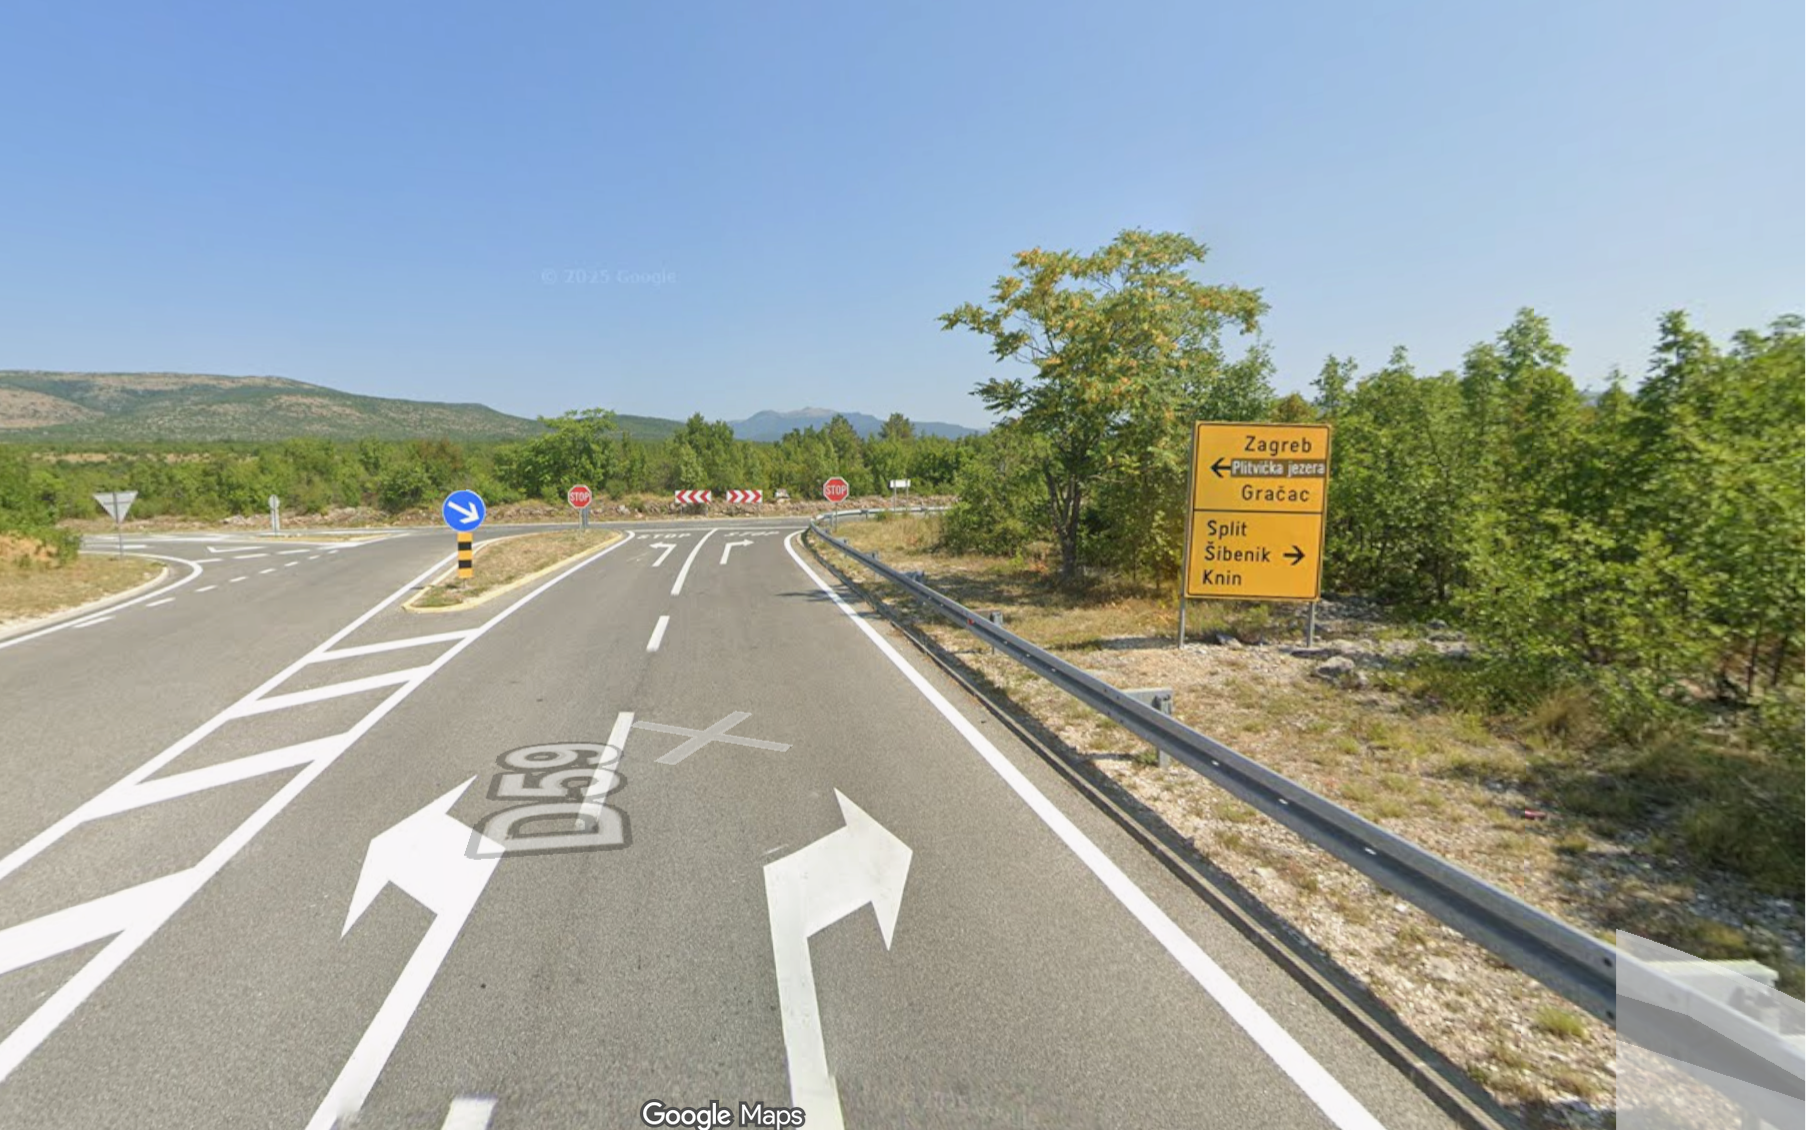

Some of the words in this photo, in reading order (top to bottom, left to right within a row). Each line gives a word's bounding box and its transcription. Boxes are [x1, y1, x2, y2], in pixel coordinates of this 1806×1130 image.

[1244, 435, 1312, 456] Zagreb
[1286, 461, 1326, 478] jezera
[570, 491, 590, 502] STOP
[825, 484, 847, 496] STOP
[1241, 484, 1310, 502] Gračac
[1206, 519, 1248, 540] Split
[1204, 541, 1271, 563] Šibenik
[1202, 569, 1242, 586] Knin
